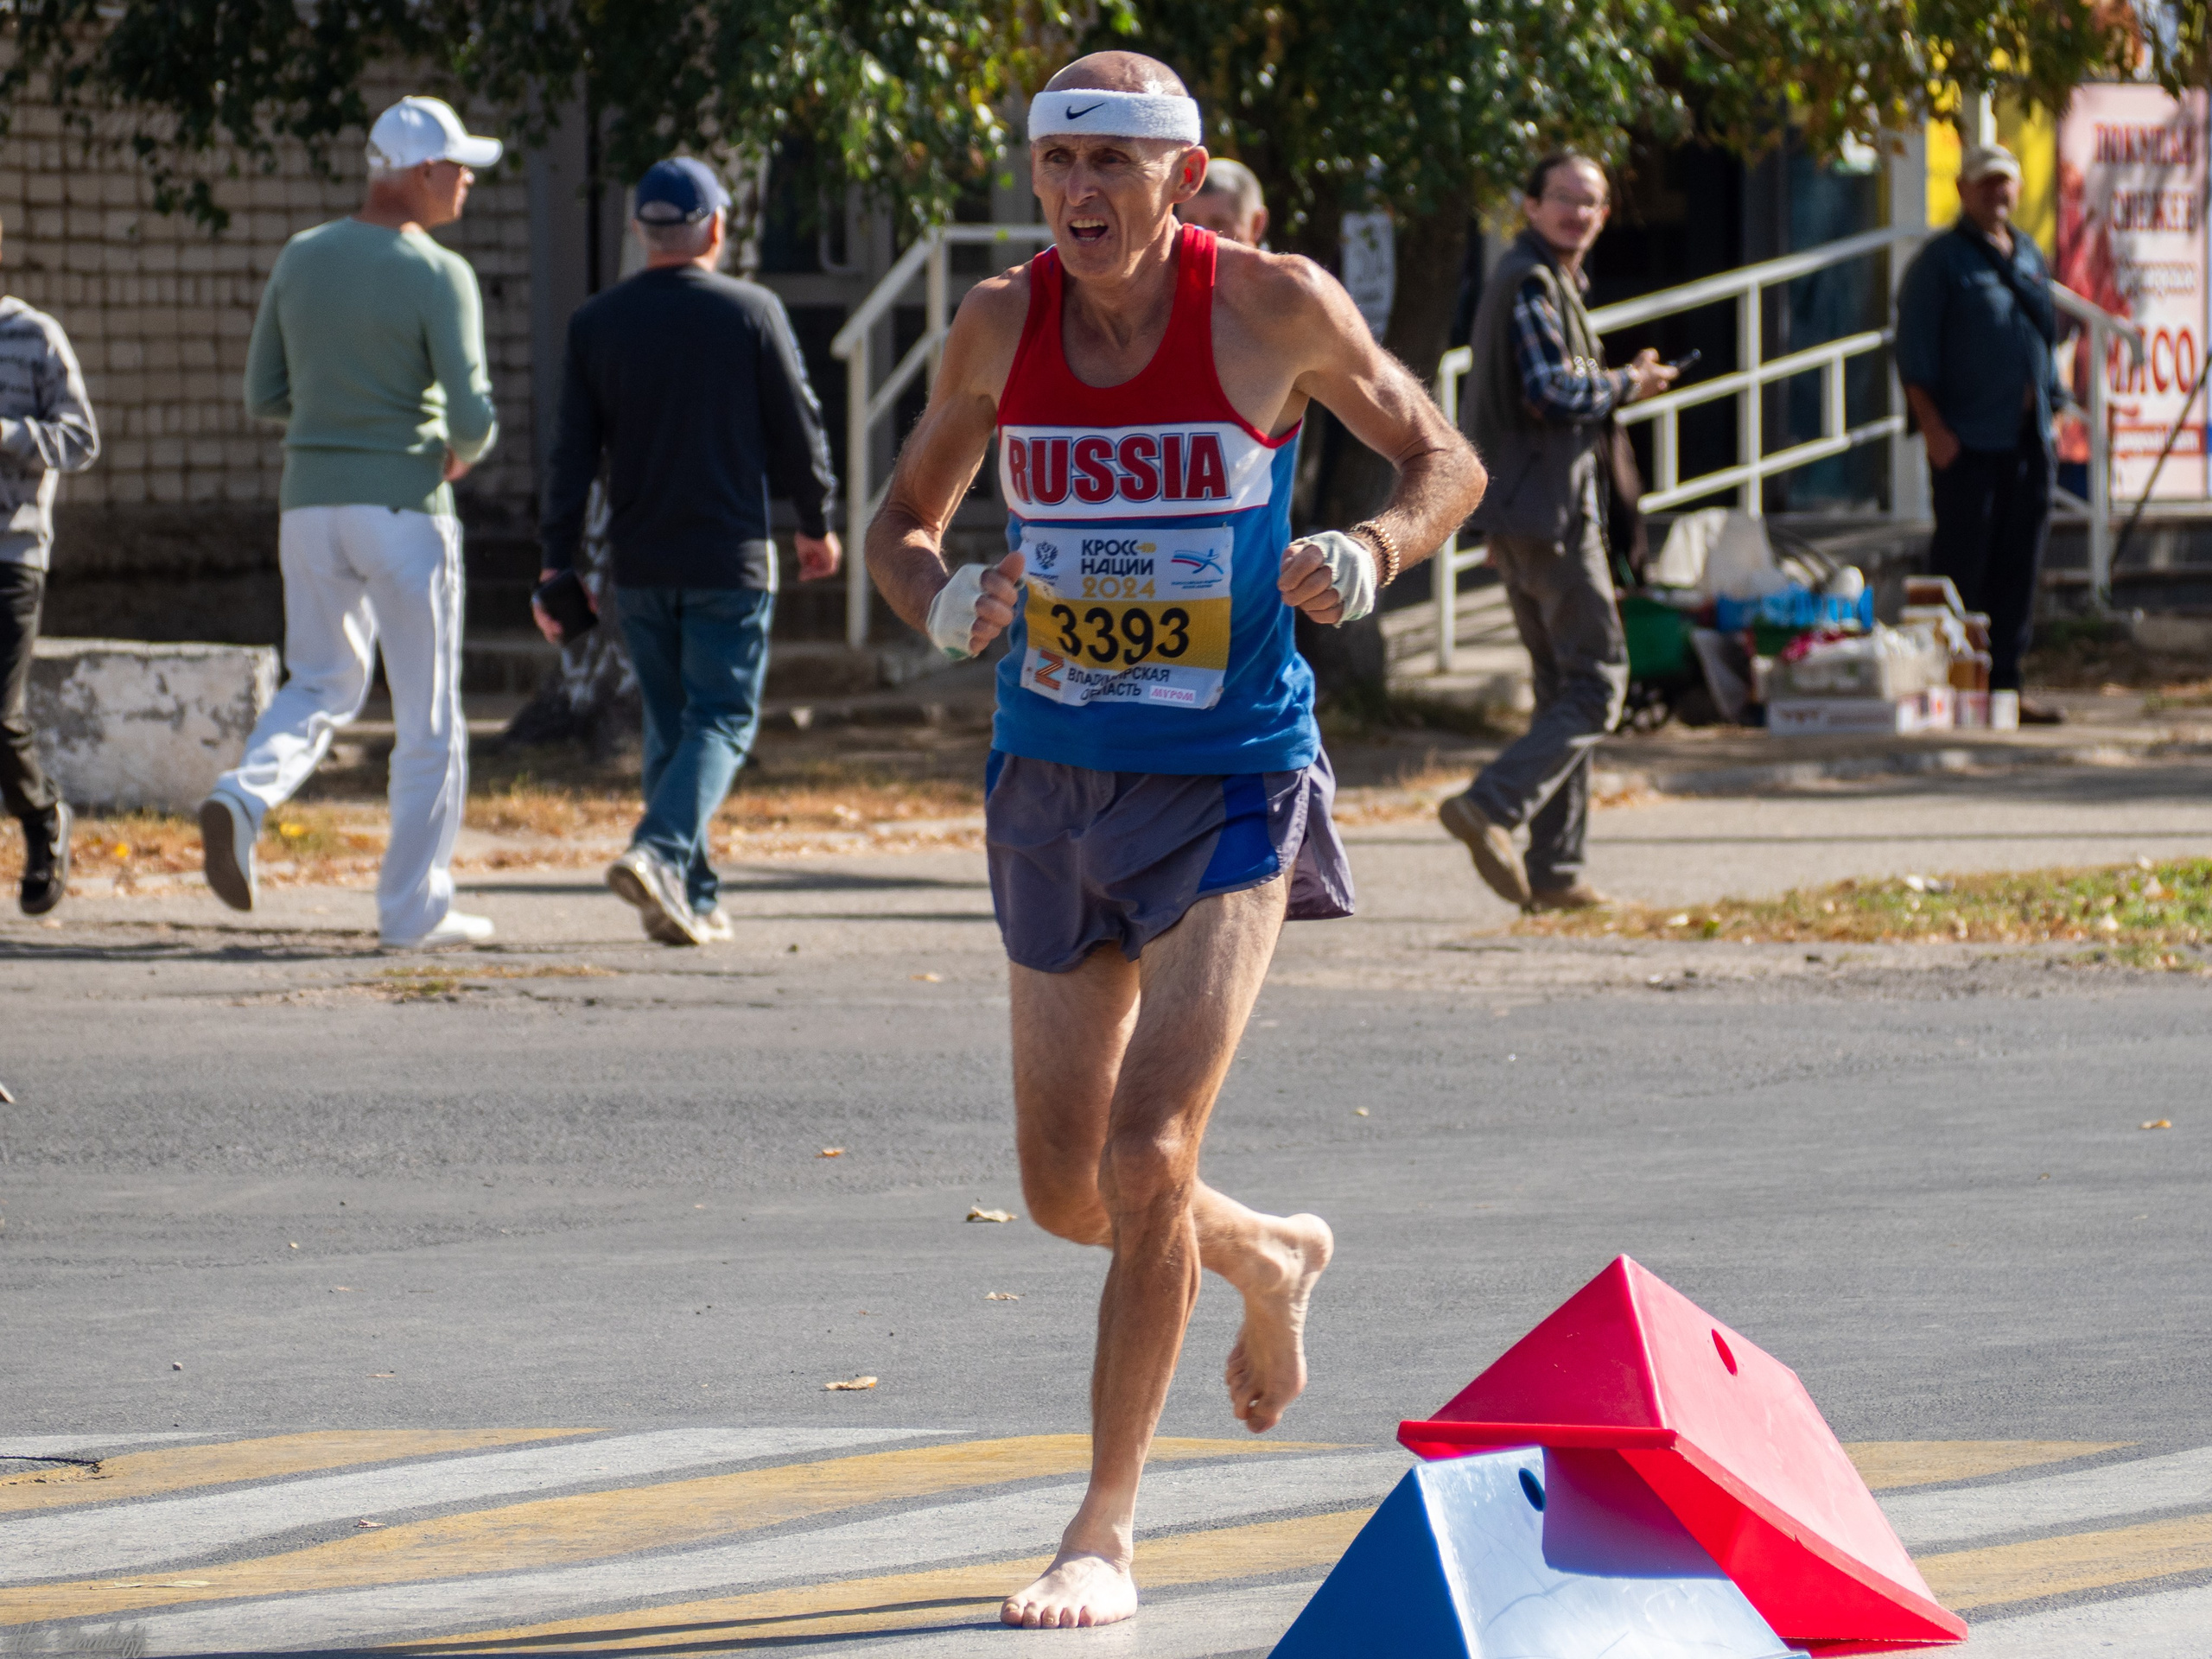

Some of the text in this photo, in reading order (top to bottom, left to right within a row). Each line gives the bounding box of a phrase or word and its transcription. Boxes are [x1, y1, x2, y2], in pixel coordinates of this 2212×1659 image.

[1007, 433, 1231, 505] RUSSIA
[1082, 539, 1138, 556] КРОСС
[1081, 558, 1154, 576] НАЦИИ
[1082, 576, 1156, 599] 2024
[1051, 604, 1190, 665] 3393
